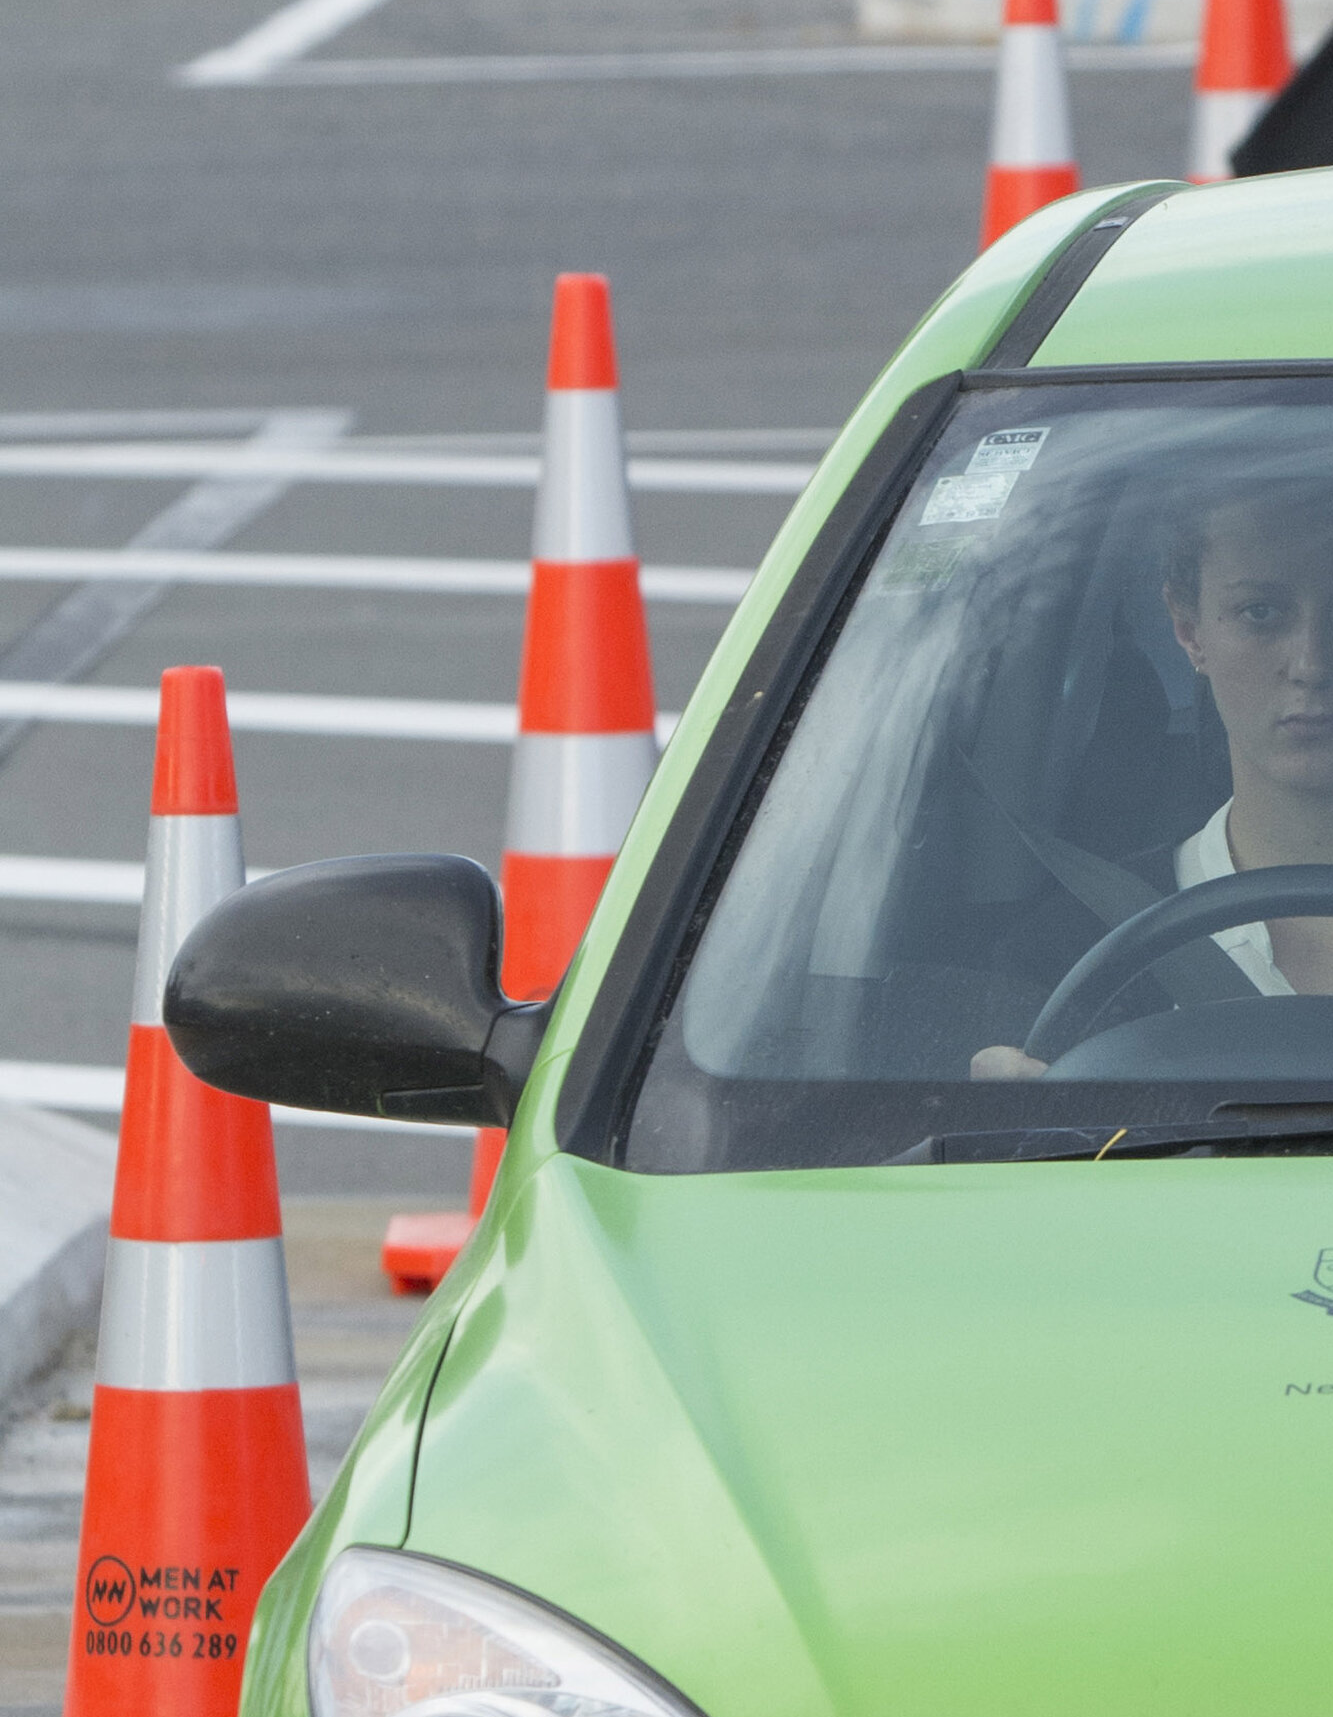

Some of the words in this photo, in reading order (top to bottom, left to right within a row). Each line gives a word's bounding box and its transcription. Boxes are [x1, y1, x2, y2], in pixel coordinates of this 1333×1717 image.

[139, 1566, 200, 1591] MEN
[207, 1568, 240, 1592] AT
[139, 1596, 223, 1621] WORK
[86, 1630, 132, 1656] 0800
[139, 1631, 183, 1658] 636
[193, 1632, 238, 1659] 289
